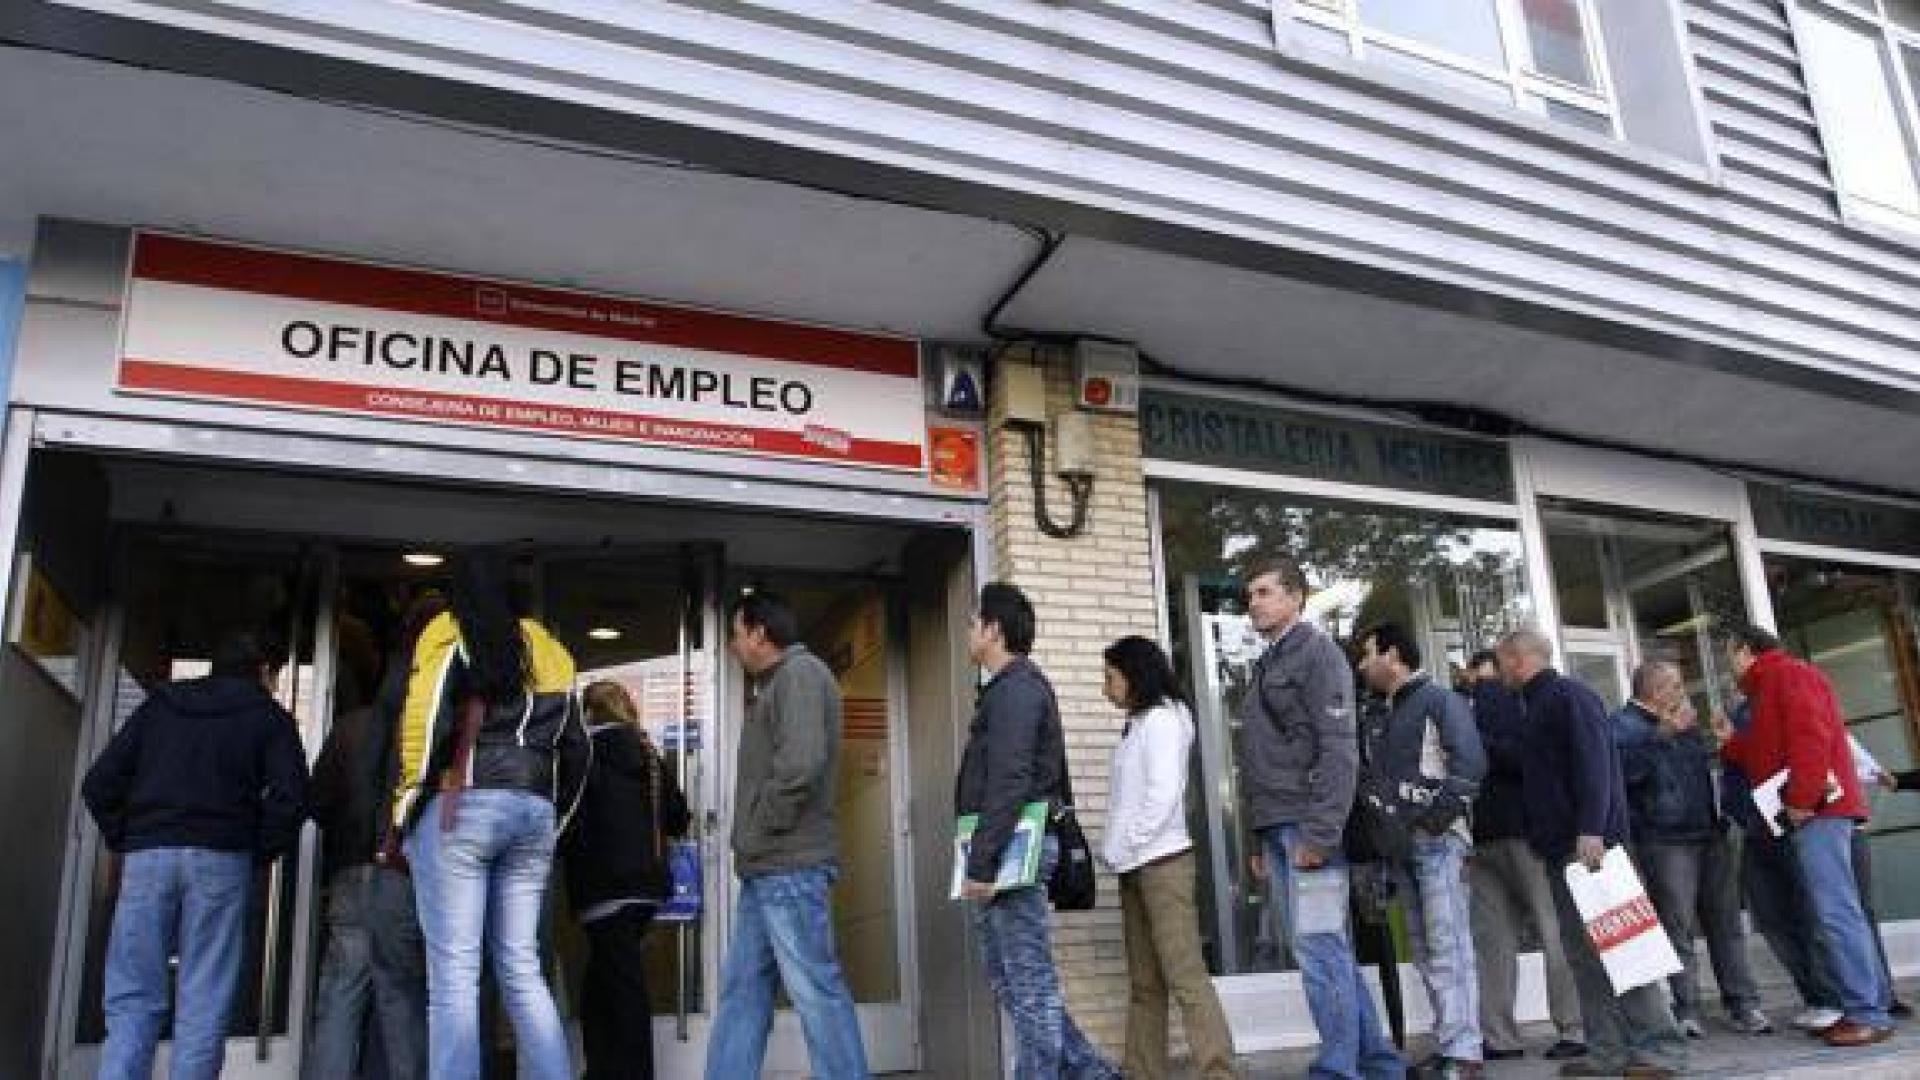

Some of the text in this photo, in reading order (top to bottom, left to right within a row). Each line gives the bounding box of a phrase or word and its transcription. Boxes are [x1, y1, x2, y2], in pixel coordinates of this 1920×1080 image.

[282, 321, 812, 414] OFICINA DE EMPLEO
